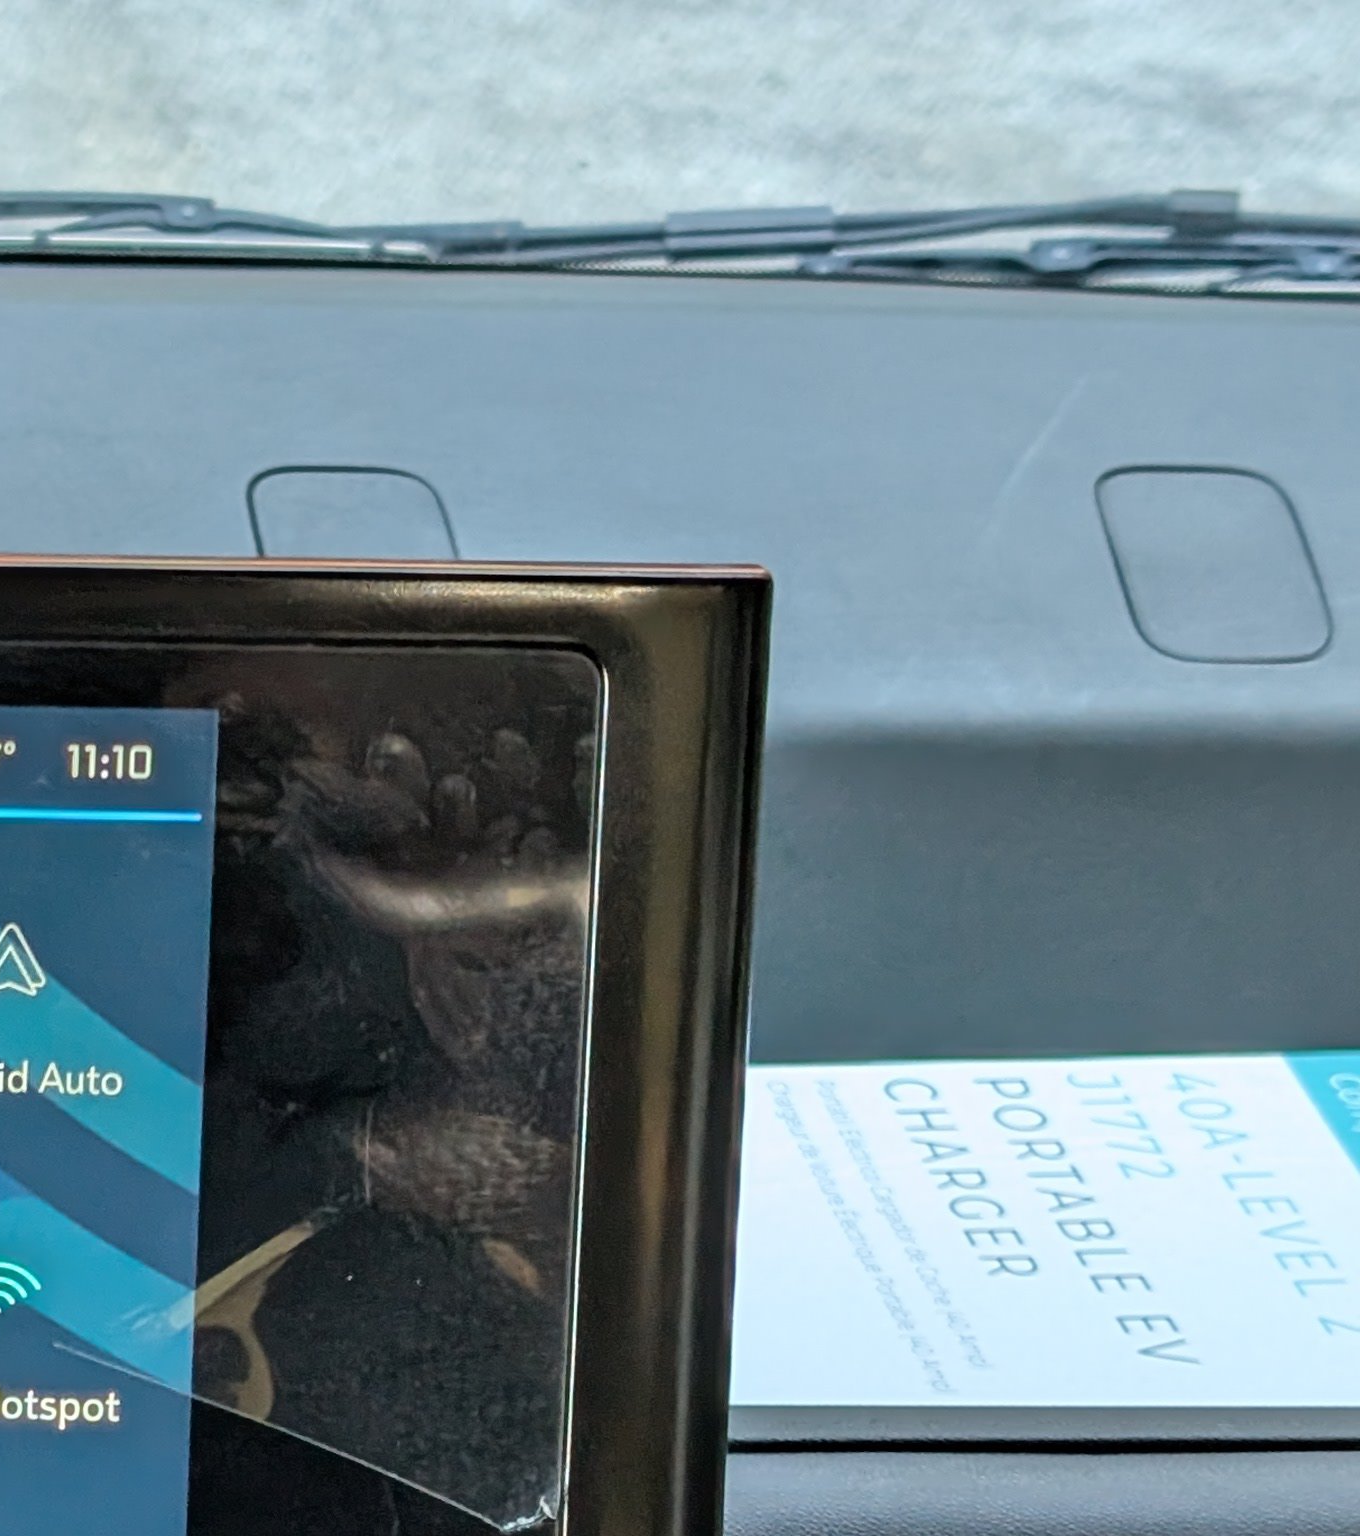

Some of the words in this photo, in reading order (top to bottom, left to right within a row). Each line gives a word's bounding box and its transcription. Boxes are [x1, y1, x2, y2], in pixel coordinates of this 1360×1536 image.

[67, 744, 154, 780] 11:10
[37, 1061, 124, 1096] Auto
[1066, 1072, 1176, 1180] J1772
[884, 1077, 1039, 1277] CHARGER
[973, 1076, 1153, 1294] PORTABLE
[1115, 1314, 1203, 1365] EV
[1166, 1071, 1347, 1298] 40A-LEVEL
